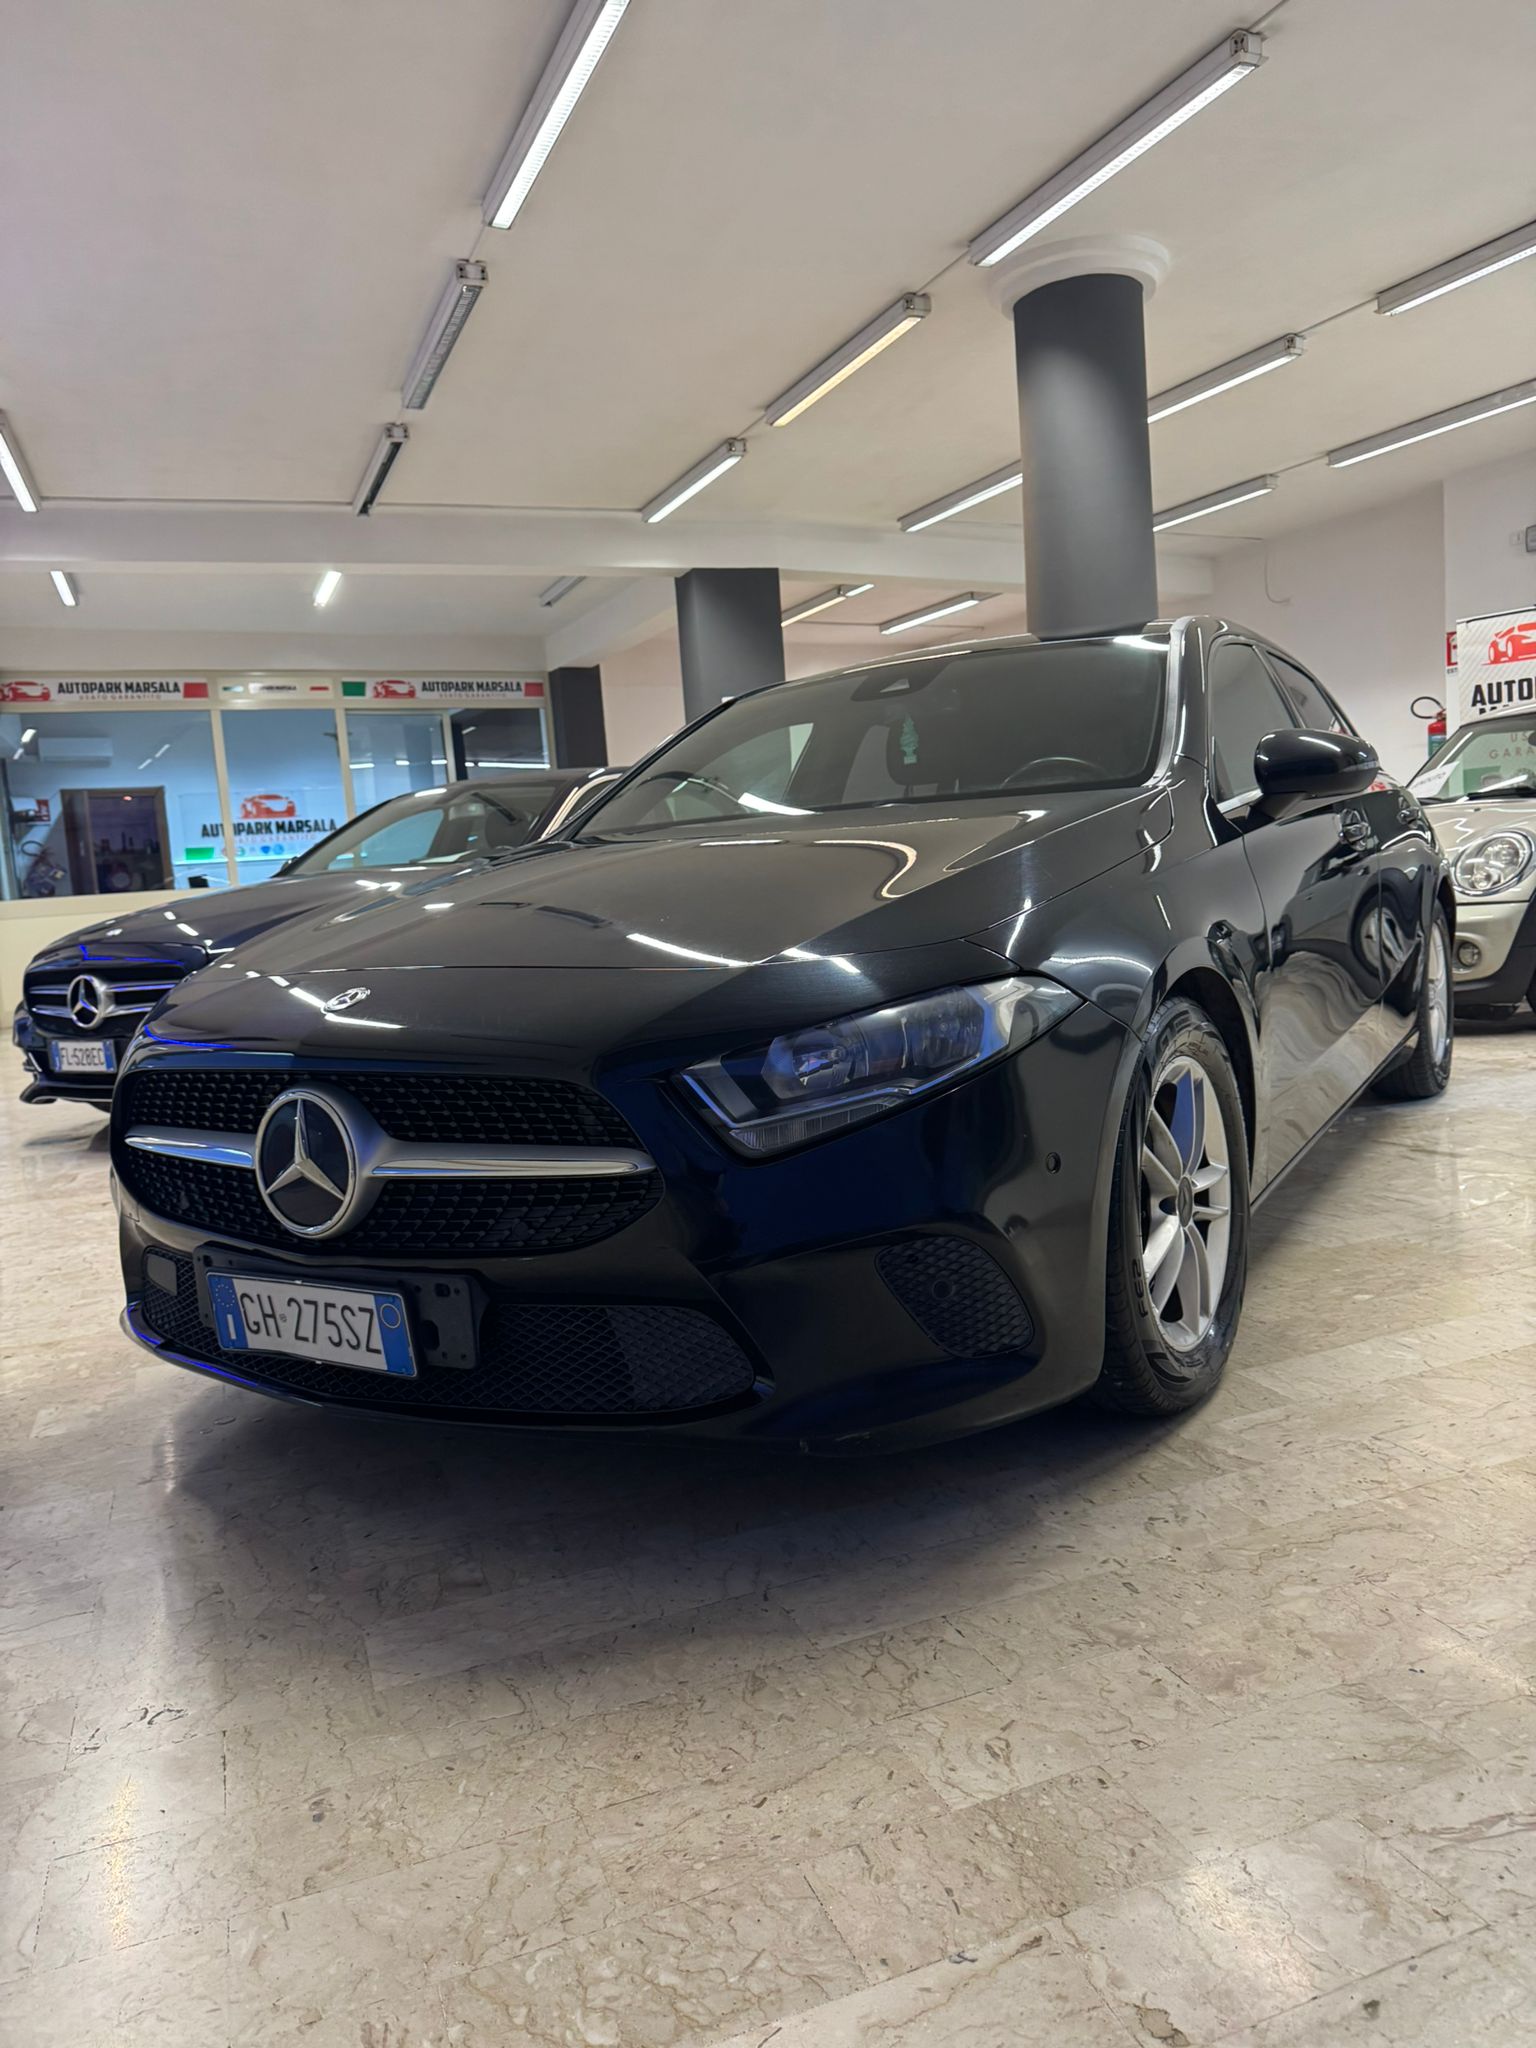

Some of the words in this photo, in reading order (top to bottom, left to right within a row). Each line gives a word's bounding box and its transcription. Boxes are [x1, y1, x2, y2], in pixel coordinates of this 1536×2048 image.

[57, 681, 122, 694] AUTOPARK
[124, 681, 181, 694] MARSALA
[421, 681, 475, 693] AUTOPARK
[476, 681, 522, 693] MARSALA
[1471, 677, 1536, 707] AUTO
[275, 818, 337, 835] MARSALA
